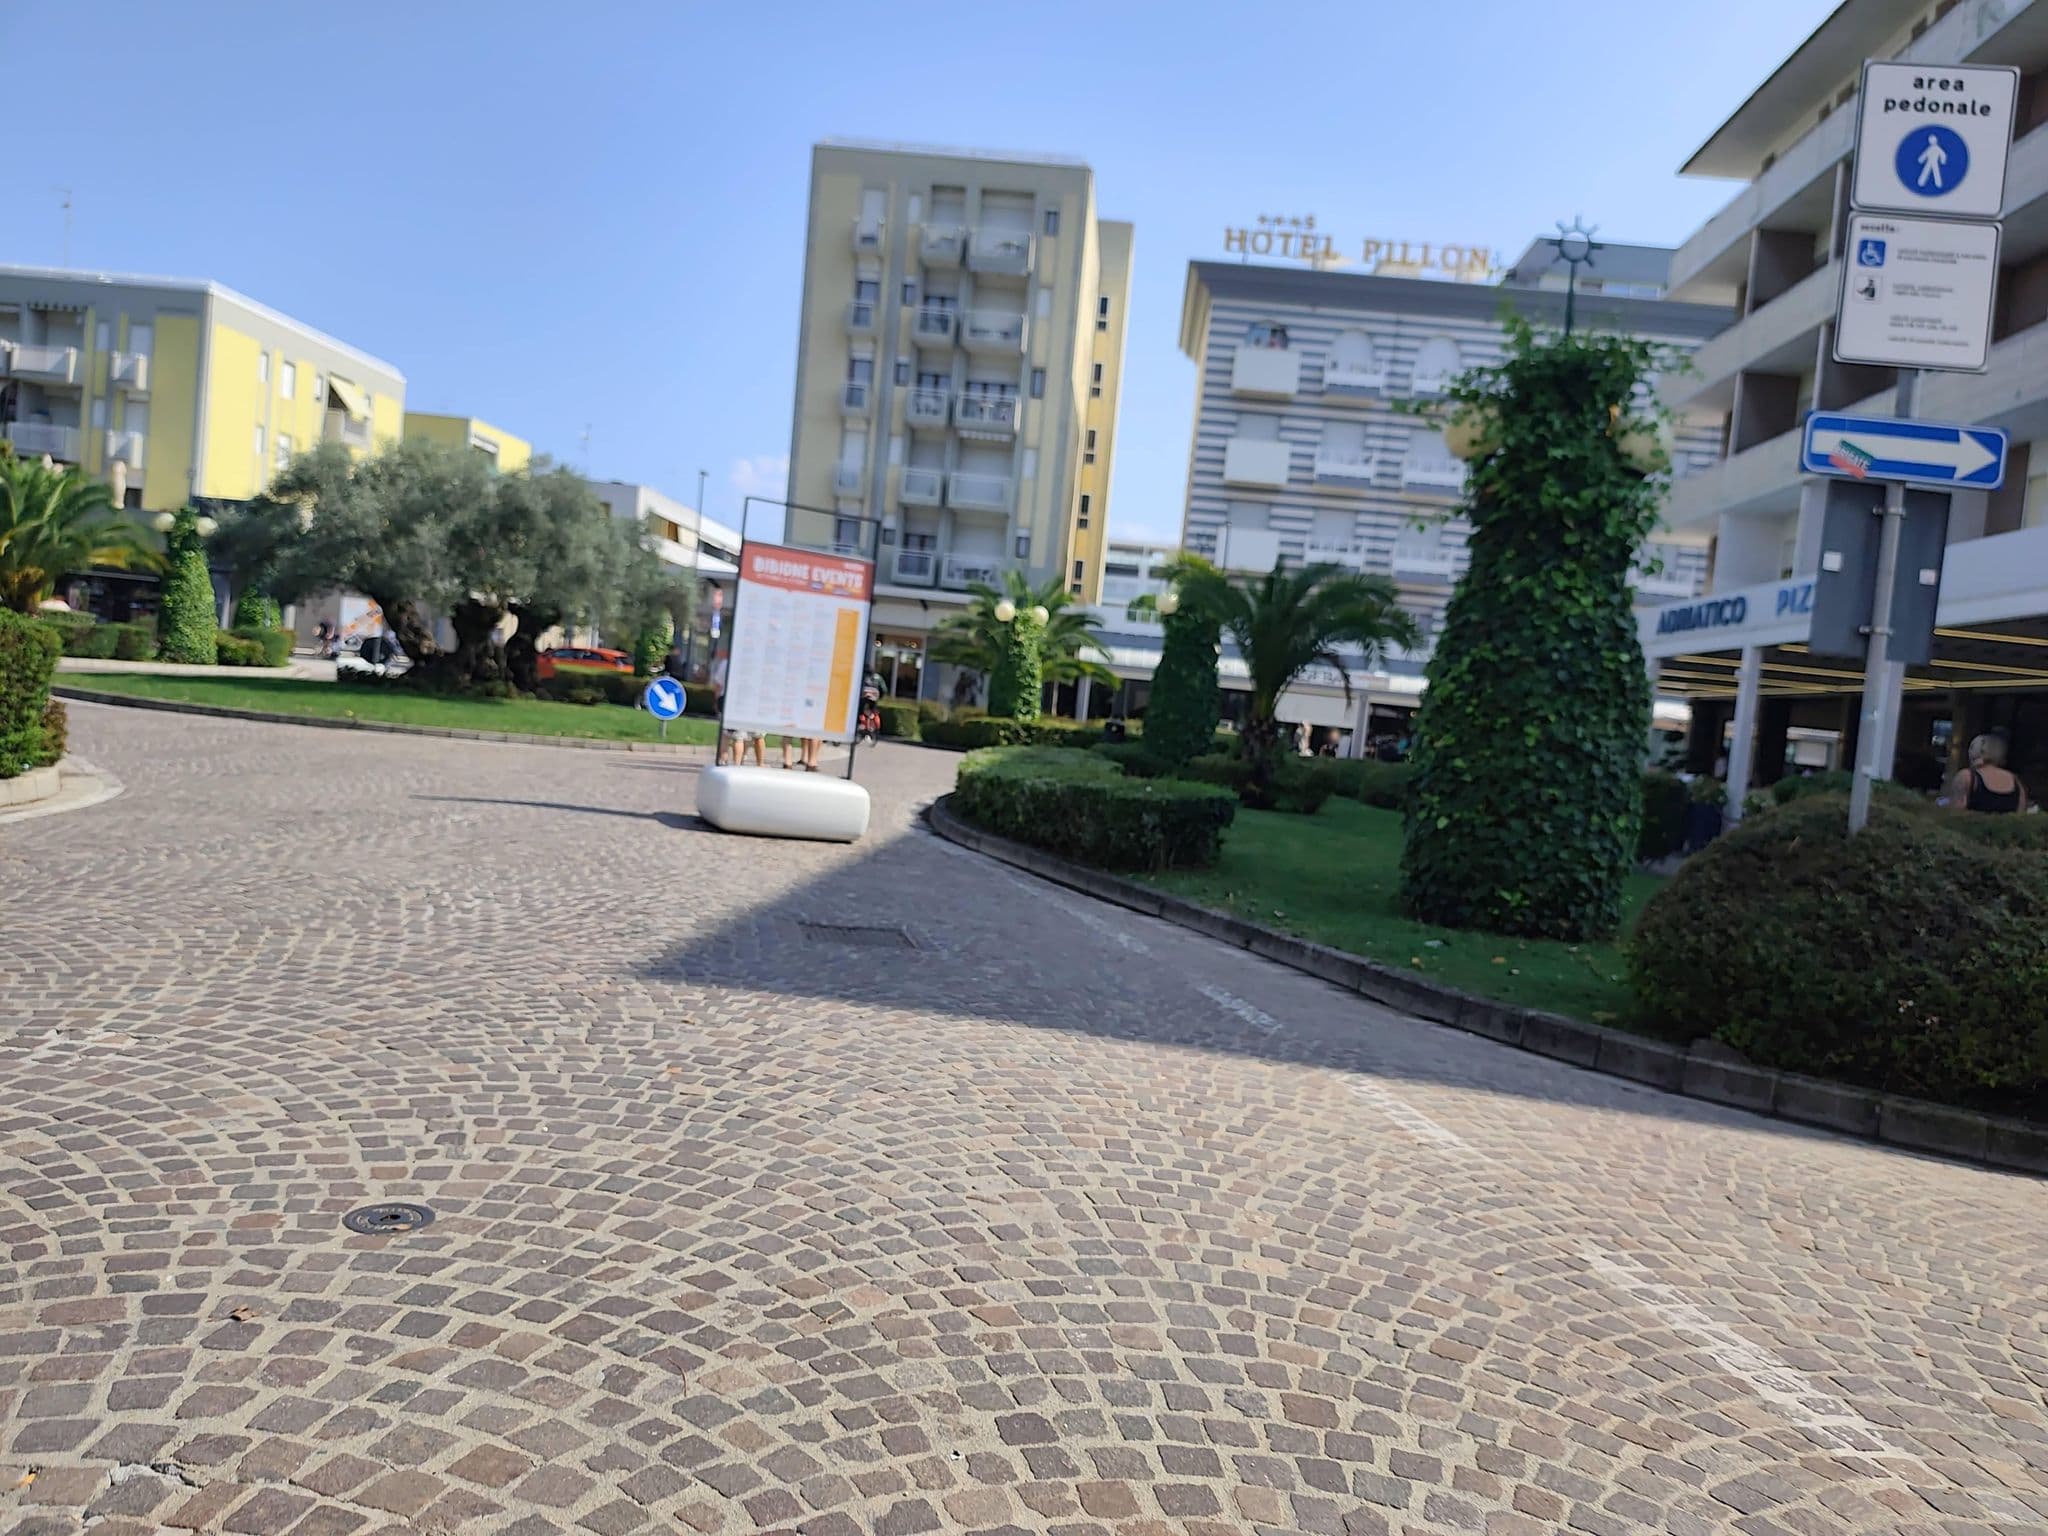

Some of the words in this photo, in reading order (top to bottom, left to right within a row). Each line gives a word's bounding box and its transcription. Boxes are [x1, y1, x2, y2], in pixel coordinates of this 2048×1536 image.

[1913, 77, 1965, 92] area
[1884, 97, 1991, 117] pedonale
[1225, 228, 1340, 260] HOTEL
[1362, 237, 1490, 272] PILLON
[812, 566, 864, 588] EVENTS
[1656, 596, 1746, 634] ADRIATICO
[1777, 584, 1814, 616] PIZ
